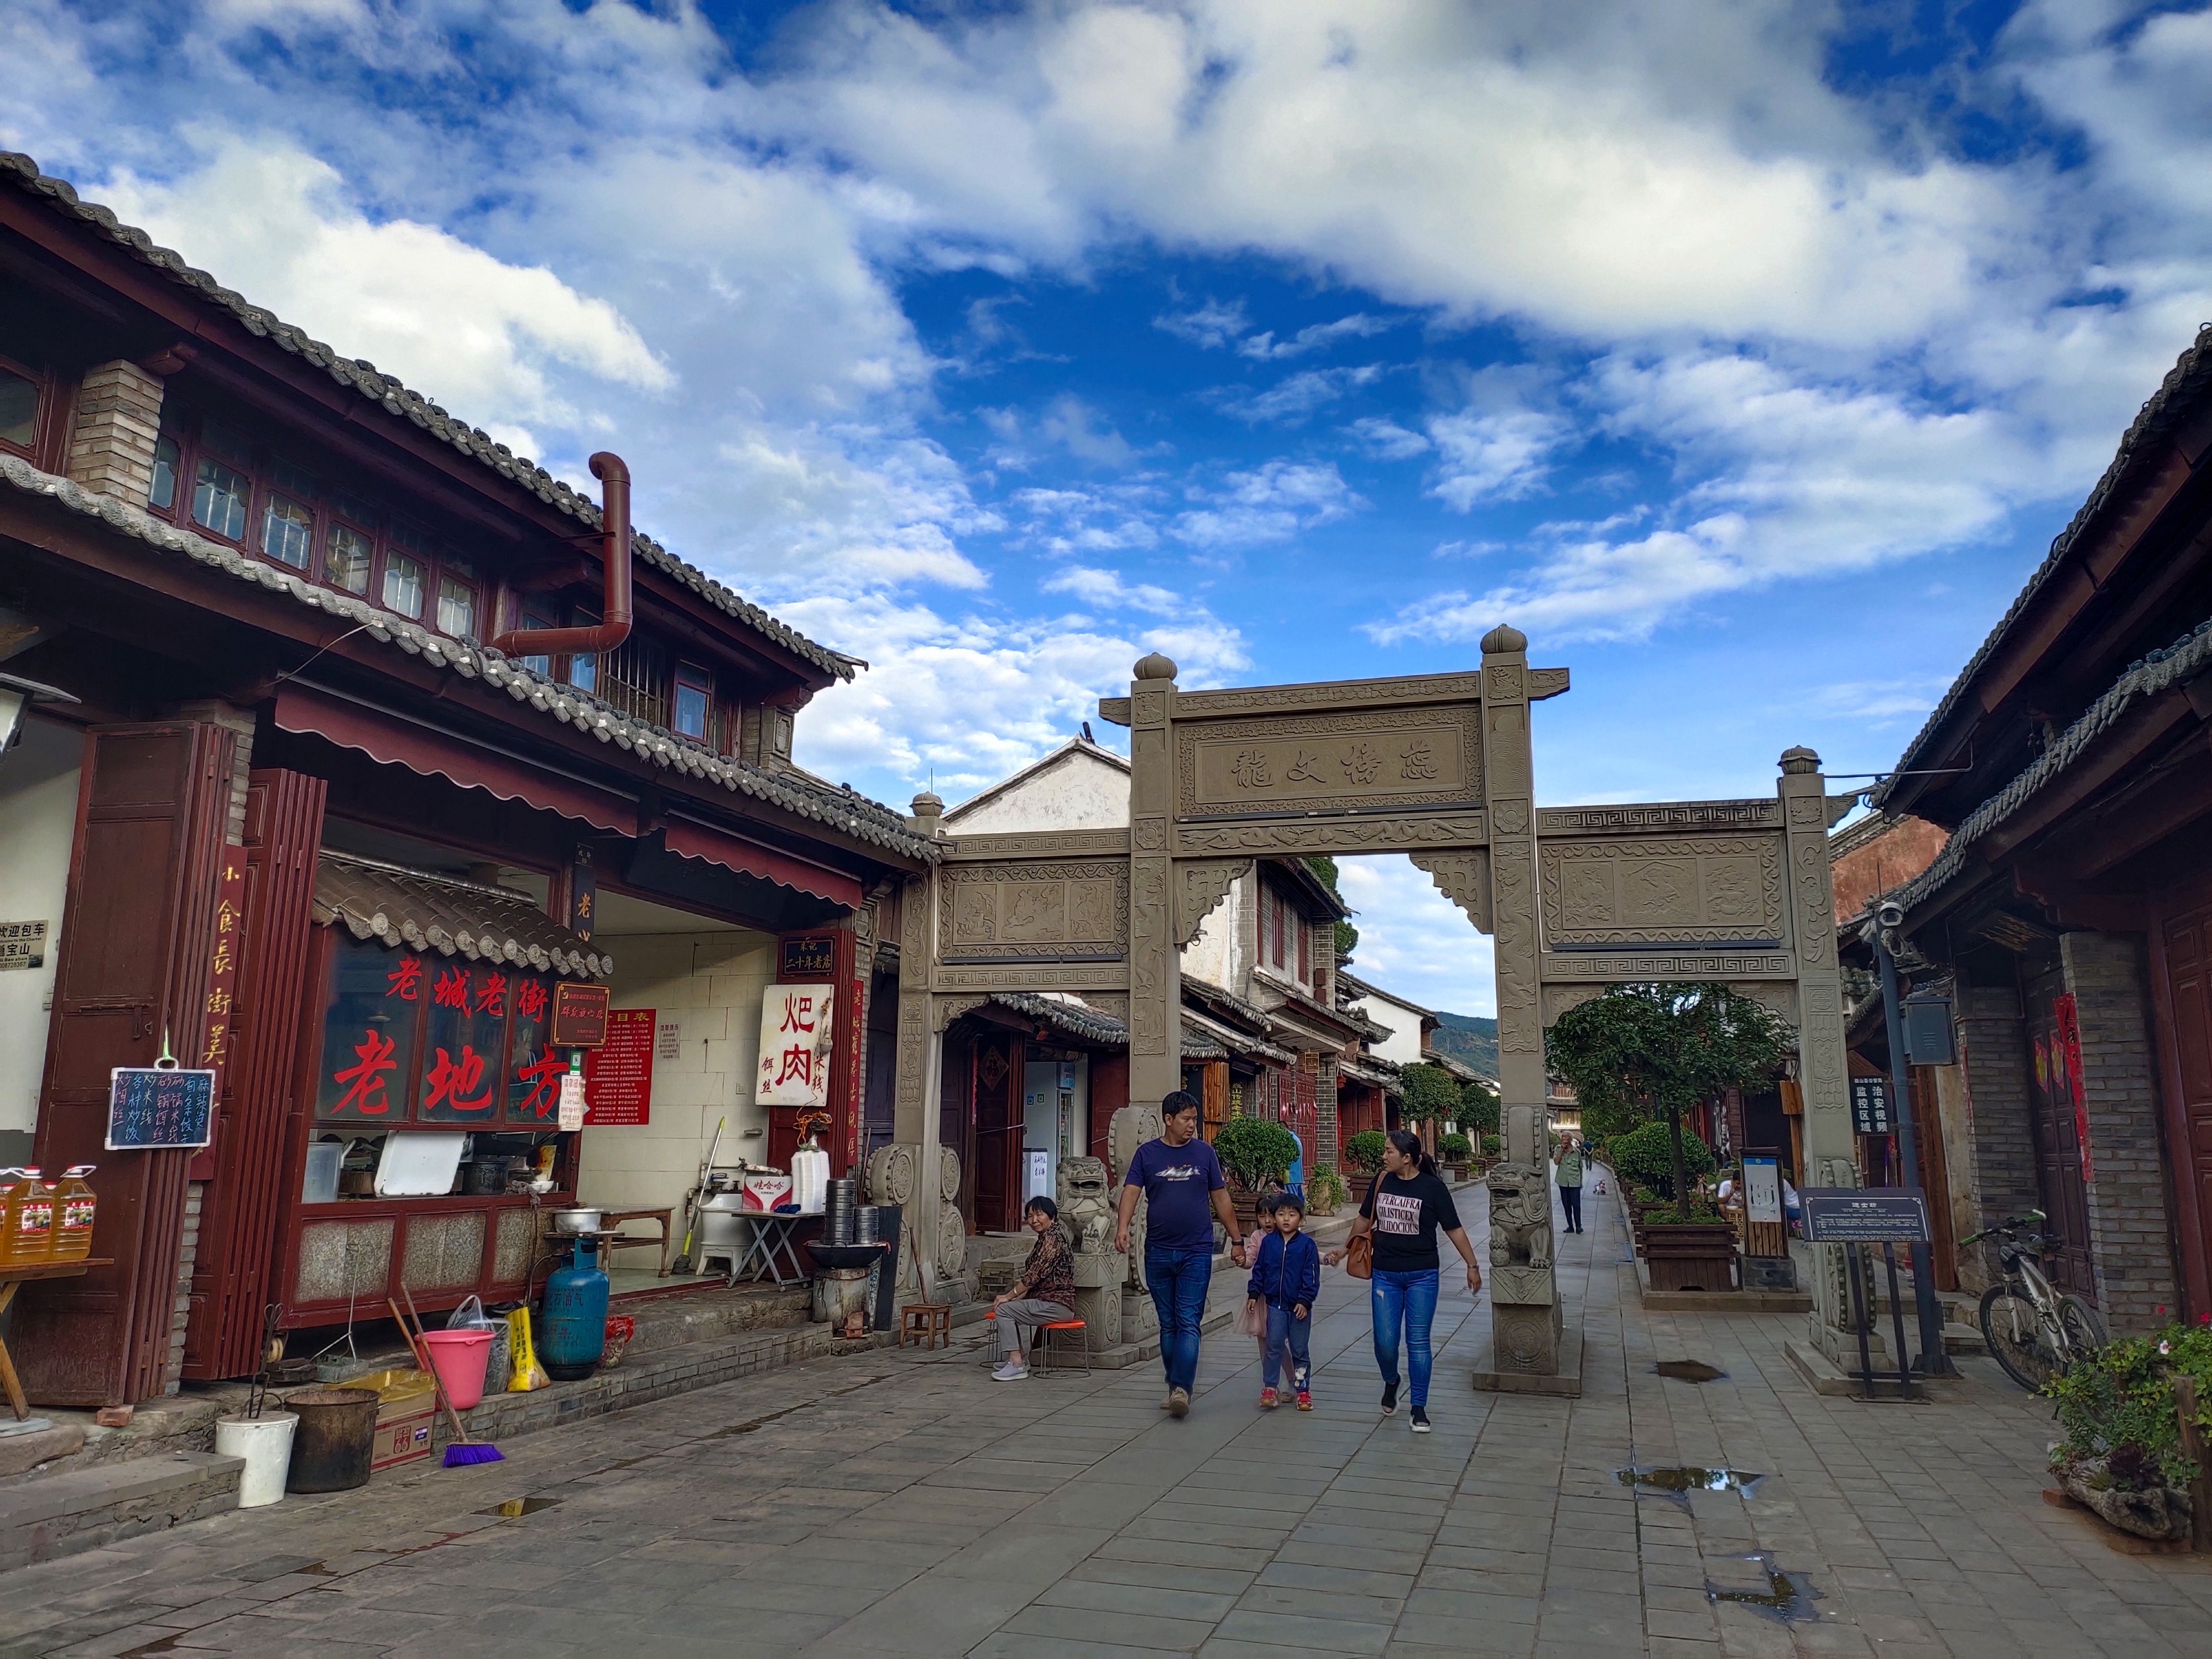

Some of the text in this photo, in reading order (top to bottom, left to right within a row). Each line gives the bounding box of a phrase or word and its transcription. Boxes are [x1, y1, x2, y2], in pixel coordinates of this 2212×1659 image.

[786, 954, 831, 971] 二十年老店
[386, 954, 549, 1023] 老城老街
[608, 1013, 650, 1022] 目表
[330, 1029, 569, 1119] 老地方
[812, 1053, 825, 1093] 米线
[1856, 1086, 1871, 1133] 监控区域
[1872, 1086, 1887, 1133] 治安视频
[753, 1180, 783, 1190] 娃哈哈
